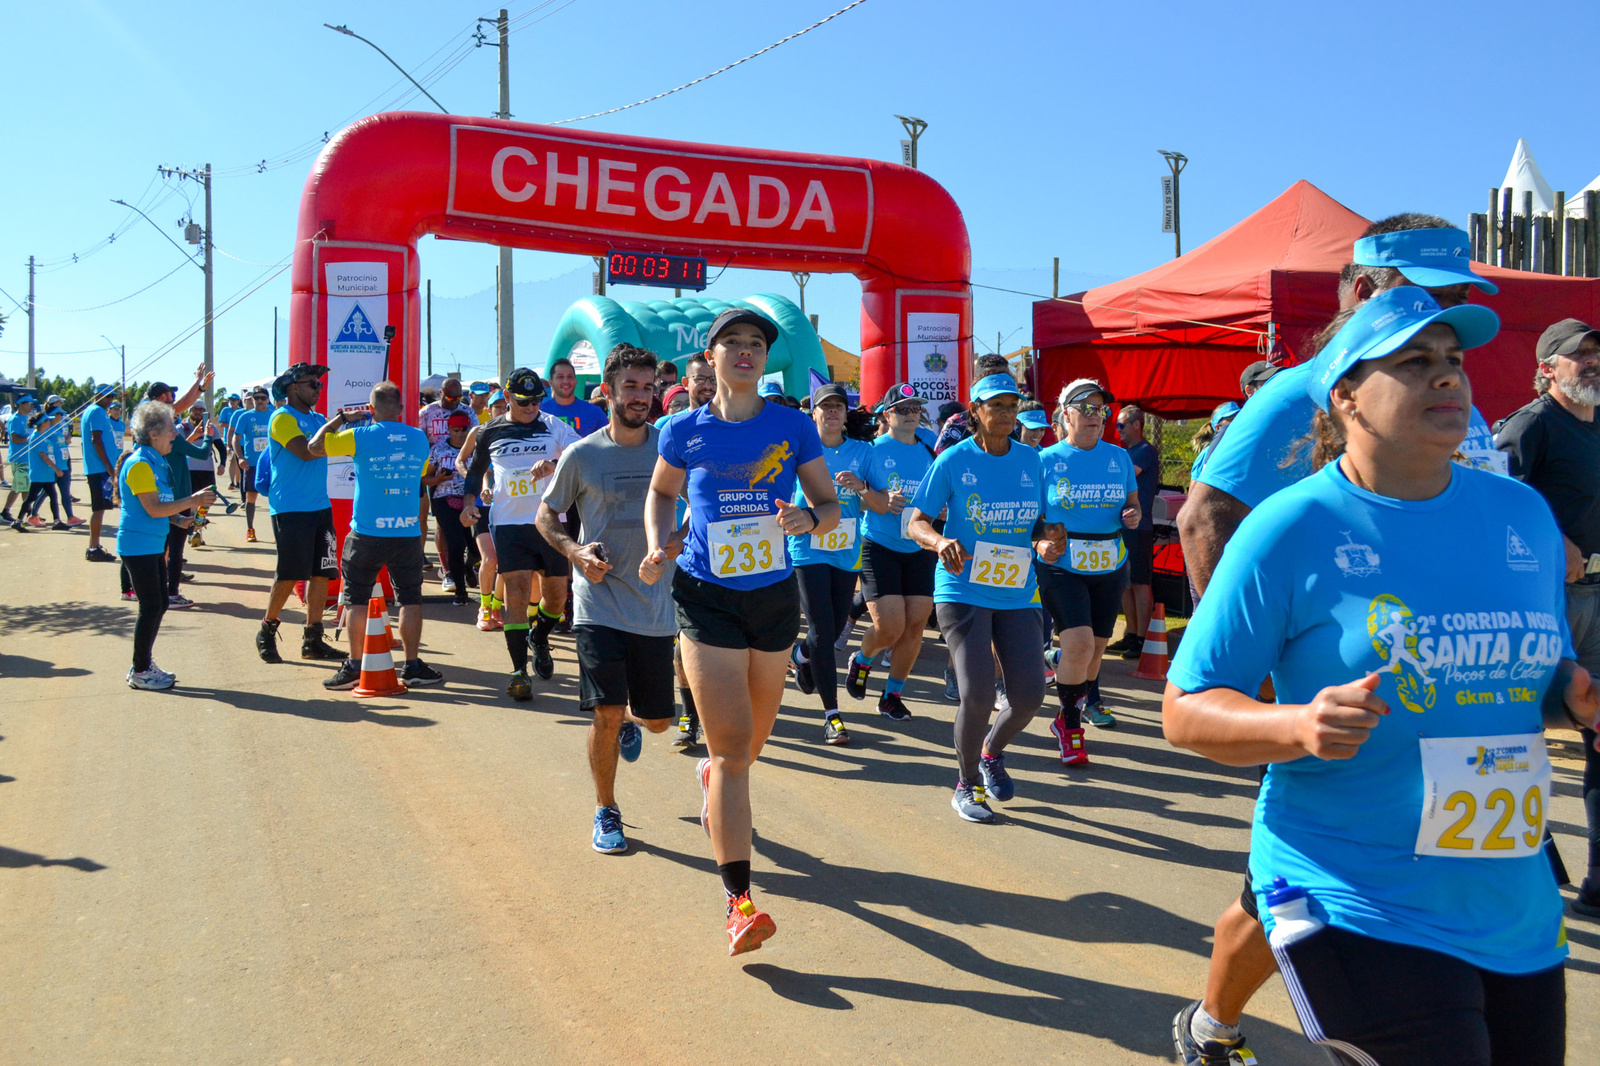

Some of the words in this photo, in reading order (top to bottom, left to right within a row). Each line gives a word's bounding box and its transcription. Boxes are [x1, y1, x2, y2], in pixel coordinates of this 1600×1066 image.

[491, 146, 837, 233] CHEGADA
[1164, 179, 1172, 195] THIS
[610, 254, 637, 276] 00
[643, 257, 670, 279] 03
[1329, 347, 1349, 370] Clinic
[344, 380, 374, 388] Apoio:
[913, 382, 950, 391] POÇOS
[917, 391, 957, 400] ALDAS
[509, 479, 537, 496] 261
[1070, 490, 1101, 500] SANTA
[1104, 490, 1126, 499] CASA
[718, 492, 753, 502] GRUPO
[756, 492, 768, 500] DE
[720, 503, 770, 514] CORRIDAS
[991, 502, 1020, 510] CORRIDA
[980, 510, 1014, 522] SANTA
[817, 532, 848, 550] 182
[718, 540, 772, 574] 233
[1076, 551, 1110, 570] 295
[976, 560, 1020, 586] 252
[1442, 611, 1524, 632] CORRIDA
[1418, 632, 1510, 670] SANTA
[1442, 662, 1486, 685] Poços
[1489, 668, 1508, 680] de
[1456, 690, 1494, 706] 6km
[1496, 692, 1504, 704] &
[1436, 785, 1542, 850] 229
